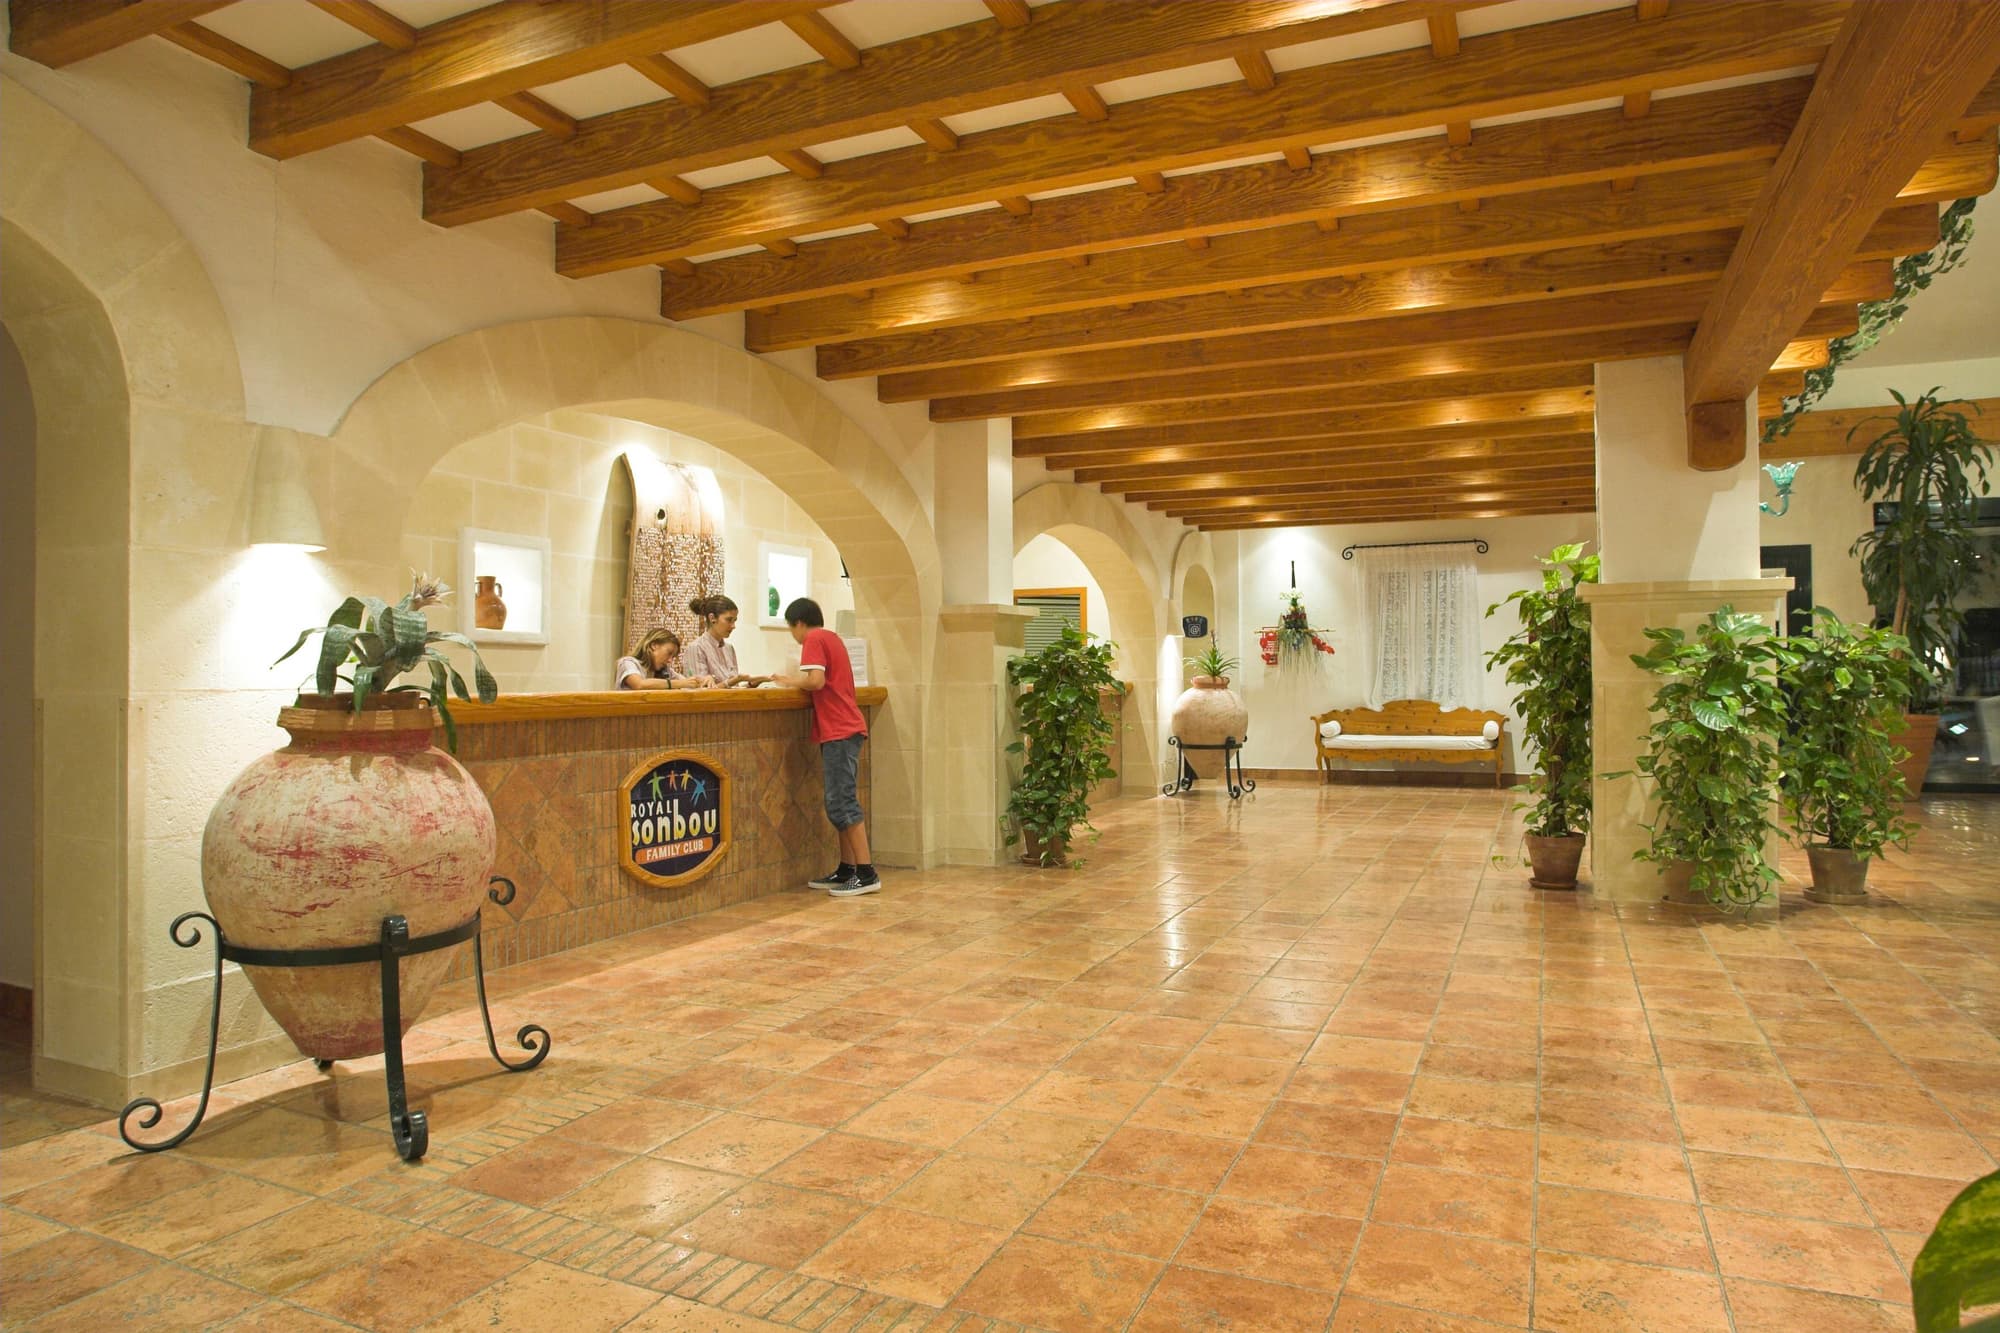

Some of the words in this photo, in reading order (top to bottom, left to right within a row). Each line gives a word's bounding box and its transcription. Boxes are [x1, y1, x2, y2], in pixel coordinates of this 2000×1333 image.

[631, 800, 672, 818] ROYAL
[632, 799, 717, 846] sonbou
[646, 844, 681, 861] FAMILY
[683, 839, 704, 854] CLUB
